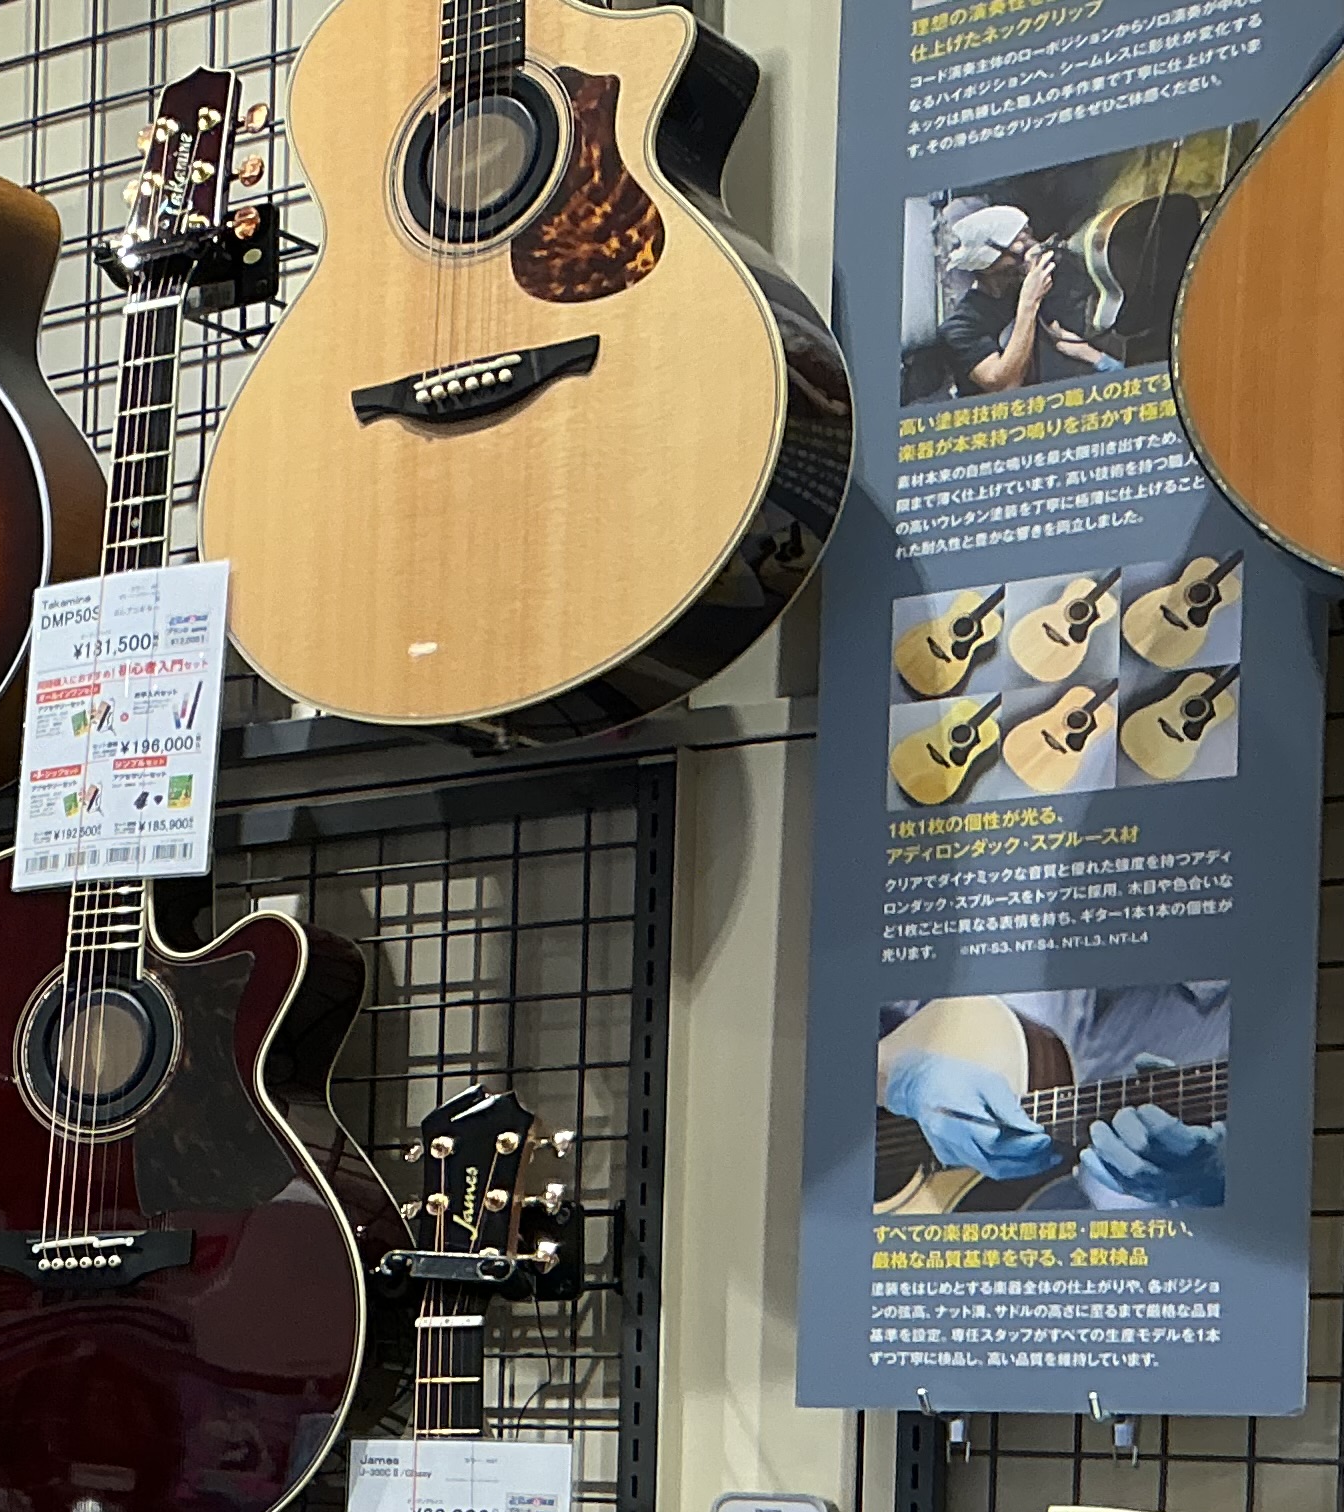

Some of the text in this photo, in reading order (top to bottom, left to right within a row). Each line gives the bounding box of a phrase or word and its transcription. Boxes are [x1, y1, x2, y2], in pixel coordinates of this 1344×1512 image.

[910, 0, 1104, 64] 仕上げたネックグリップ
[42, 608, 100, 630] DMP50S
[120, 735, 194, 755] ¥196,000
[888, 808, 1065, 839] 1枚1枚の個性が光る、
[886, 825, 1141, 865] アディロンダック・スプルース材
[872, 1220, 1194, 1244] すべての楽器の状態確認・調整を行い、
[872, 1248, 1149, 1270] 厳格な品質基準を守る、全数検品
